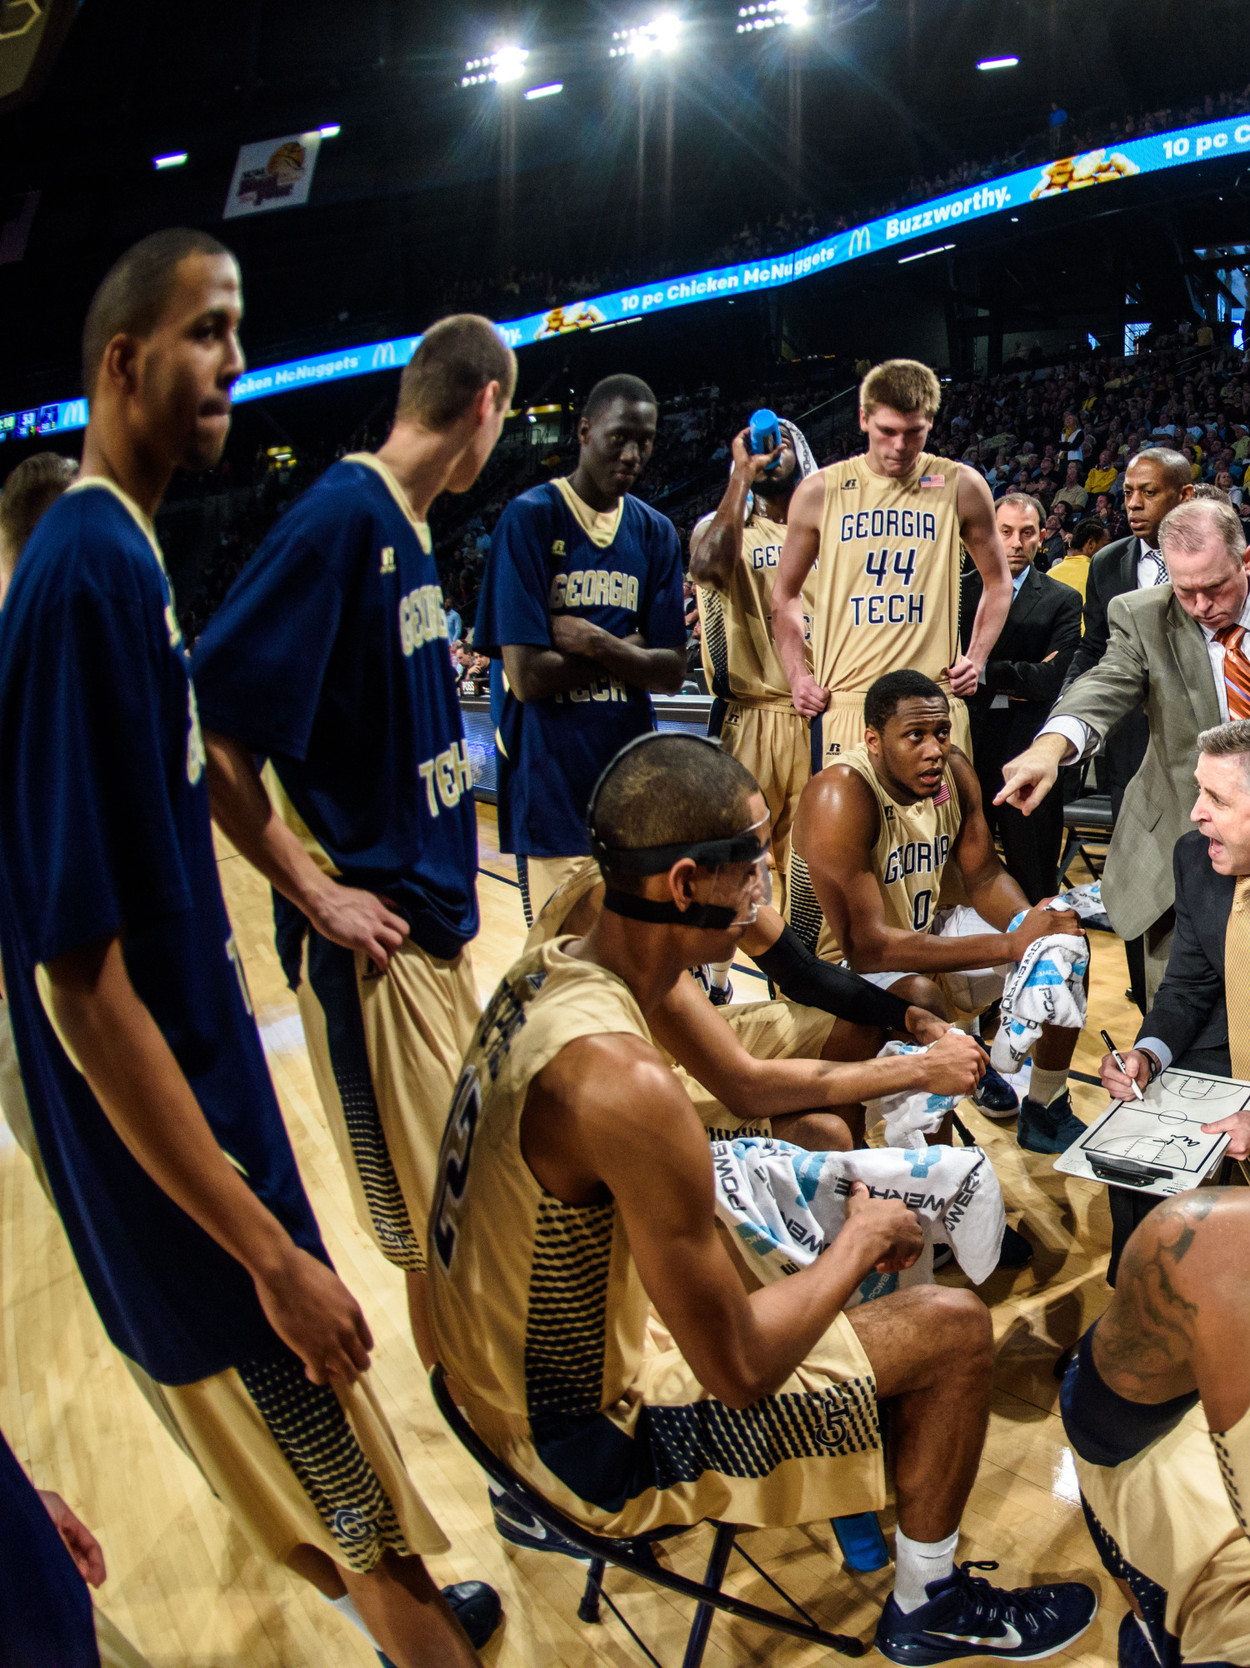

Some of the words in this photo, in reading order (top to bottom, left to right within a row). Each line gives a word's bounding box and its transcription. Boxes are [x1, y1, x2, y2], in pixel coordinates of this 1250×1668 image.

[1163, 137, 1189, 159] 10
[1195, 132, 1229, 157] pc
[886, 186, 1012, 240] Buzzworthy.
[621, 293, 640, 311] 10
[642, 291, 664, 310] pc
[667, 274, 739, 300] Chicken
[840, 508, 936, 543] GEORGIA
[865, 547, 917, 588] 44
[551, 569, 640, 613] GEORGIA
[850, 593, 925, 626] TECH
